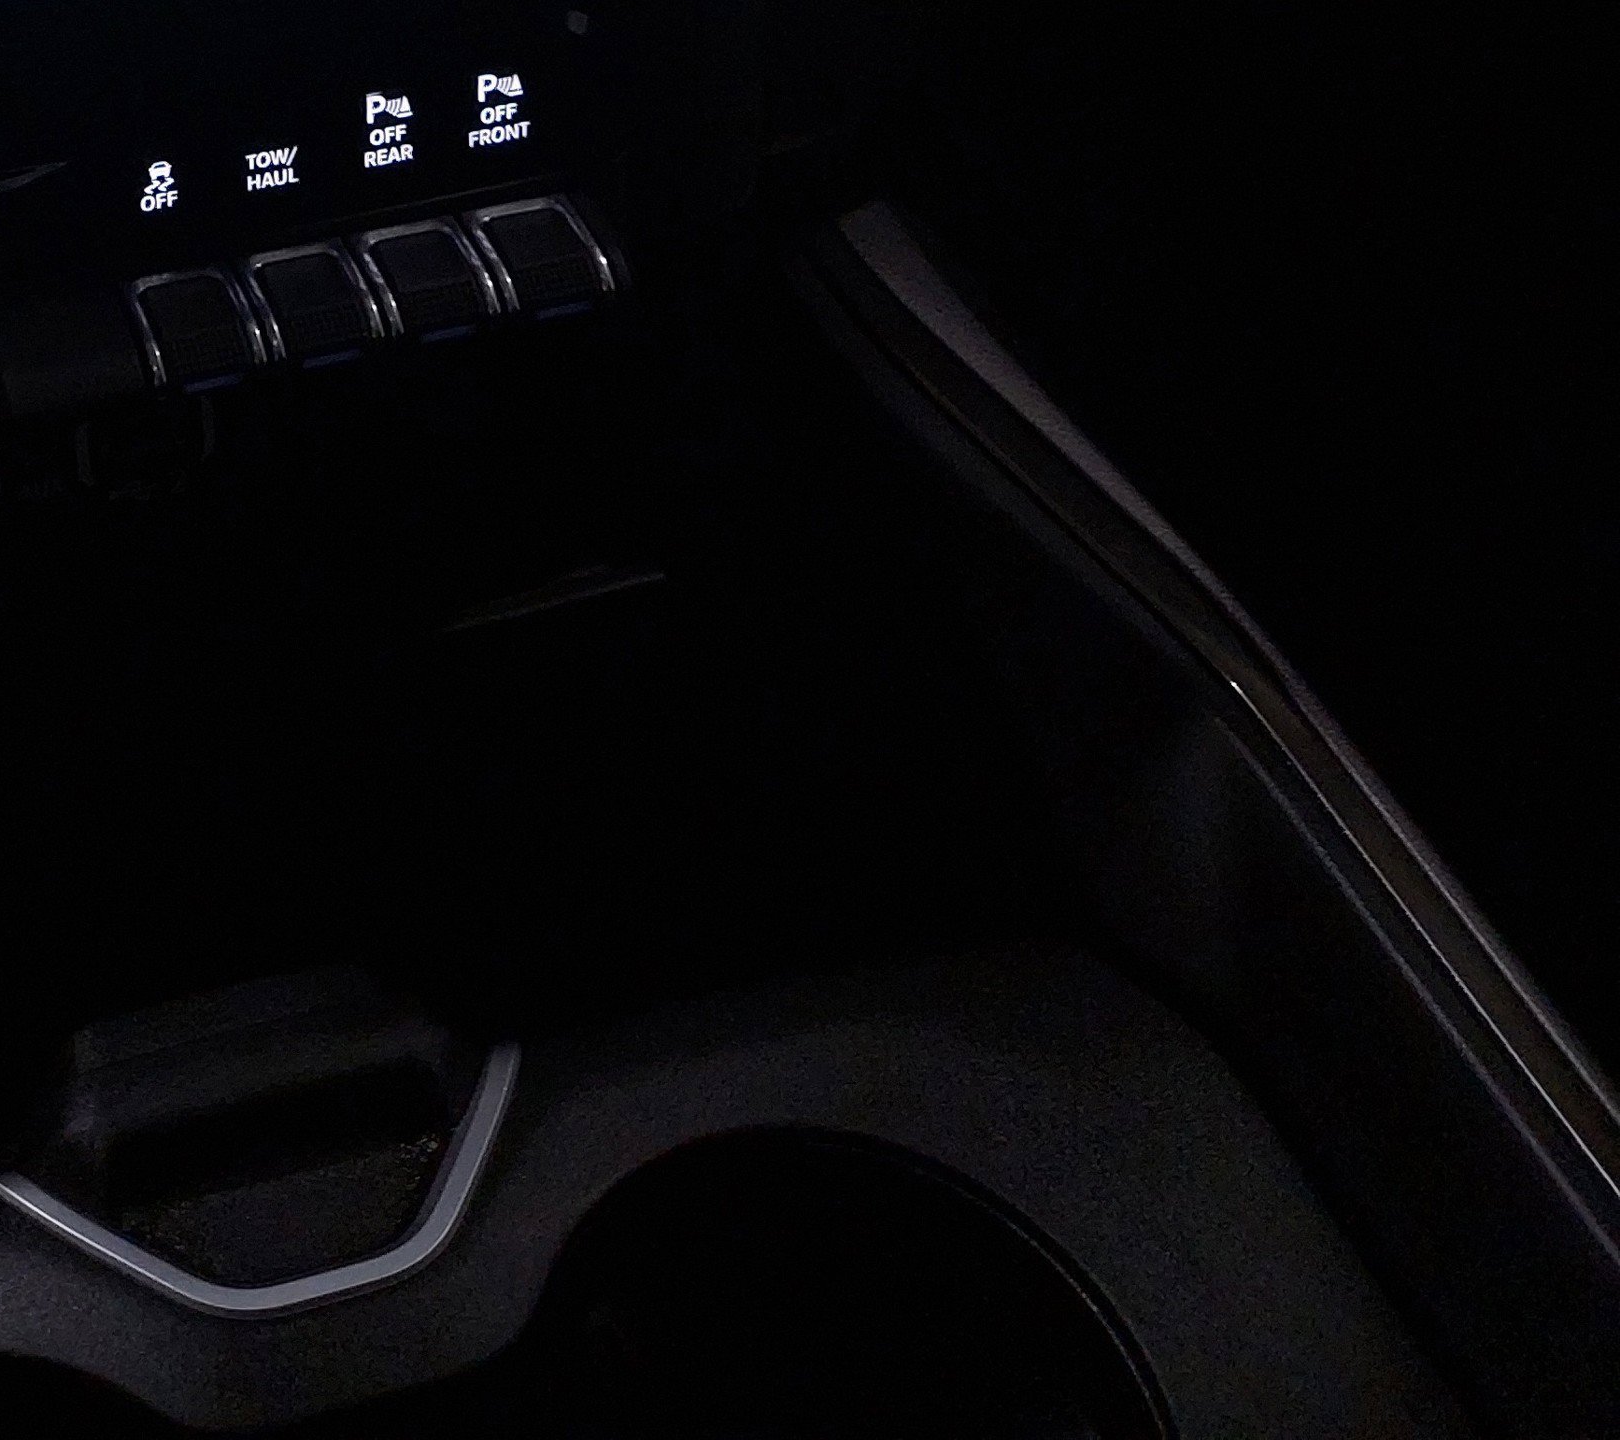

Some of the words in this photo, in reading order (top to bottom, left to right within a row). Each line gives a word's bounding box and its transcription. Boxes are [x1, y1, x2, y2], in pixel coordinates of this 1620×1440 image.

[480, 103, 518, 125] OFF
[370, 123, 408, 146] OFF
[468, 121, 531, 148] FRONT
[245, 146, 298, 171] TOW/
[363, 144, 414, 168] REAR
[246, 168, 300, 192] HAUL
[140, 191, 179, 212] OFF
